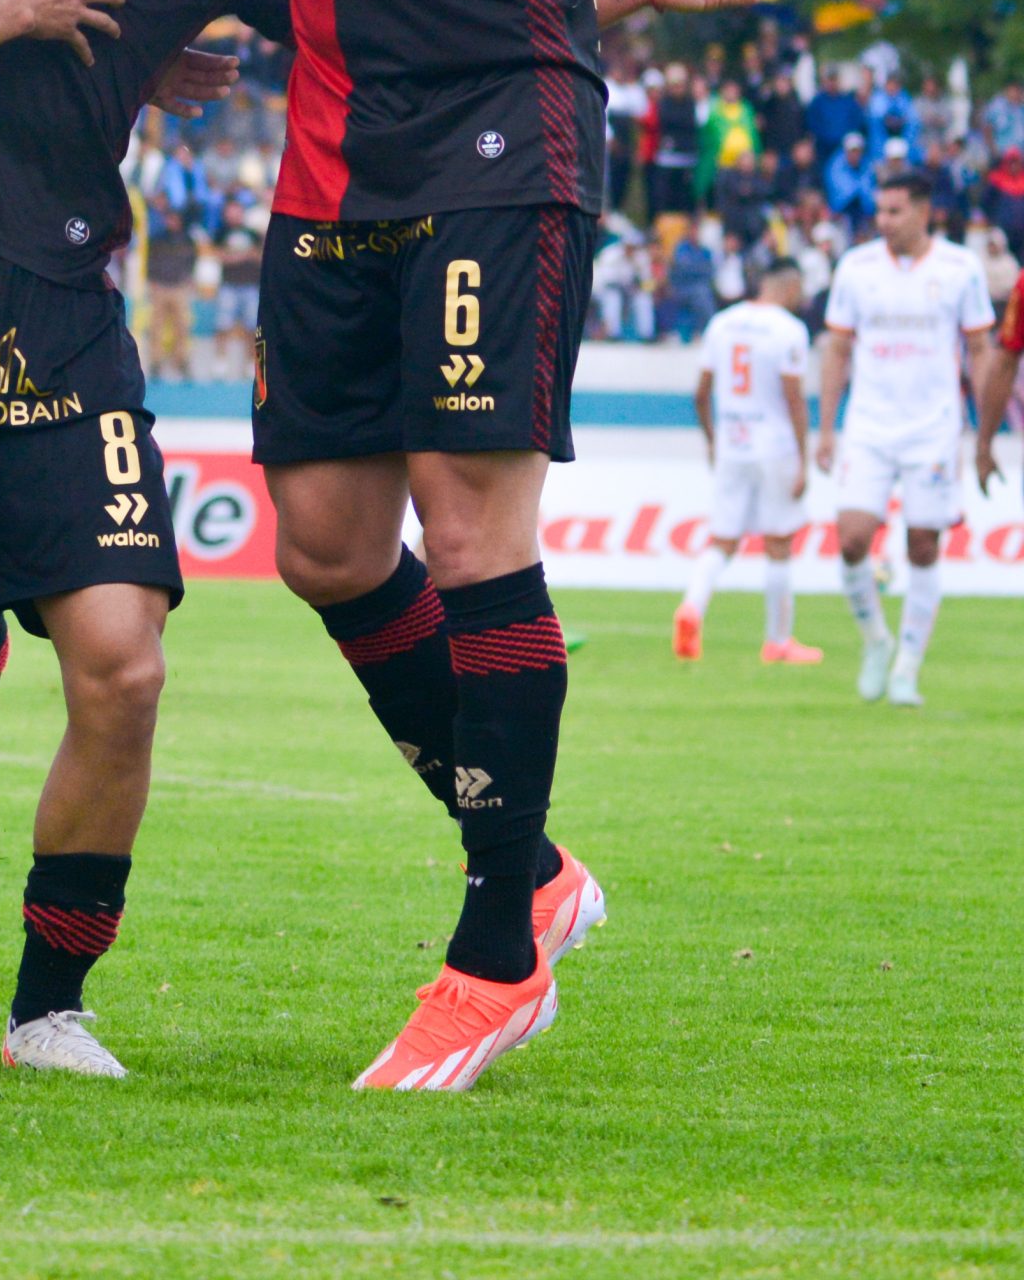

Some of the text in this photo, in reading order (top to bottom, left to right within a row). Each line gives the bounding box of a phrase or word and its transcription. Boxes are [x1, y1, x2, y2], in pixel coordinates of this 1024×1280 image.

[444, 259, 481, 347] 6
[731, 343, 752, 397] 5
[433, 393, 495, 412] walon
[99, 410, 141, 486] 8
[97, 528, 160, 548] walon
[457, 796, 503, 809] alon
